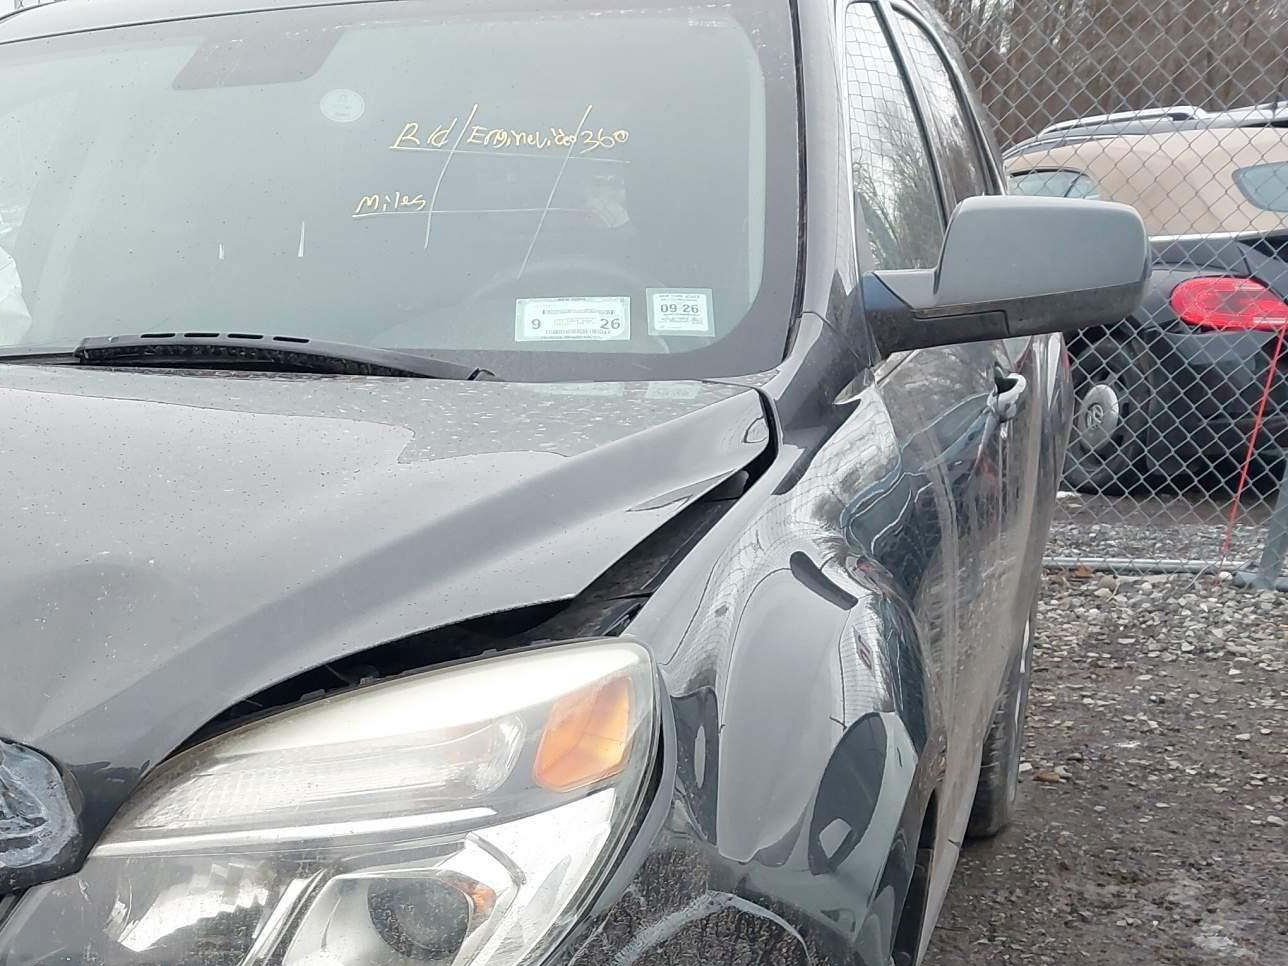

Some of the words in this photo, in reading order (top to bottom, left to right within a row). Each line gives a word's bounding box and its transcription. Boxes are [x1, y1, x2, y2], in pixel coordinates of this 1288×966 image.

[580, 126, 630, 153] 360
[661, 303, 678, 313] 09
[682, 304, 699, 313] 26
[531, 318, 541, 330] 9
[600, 318, 622, 330] 26
